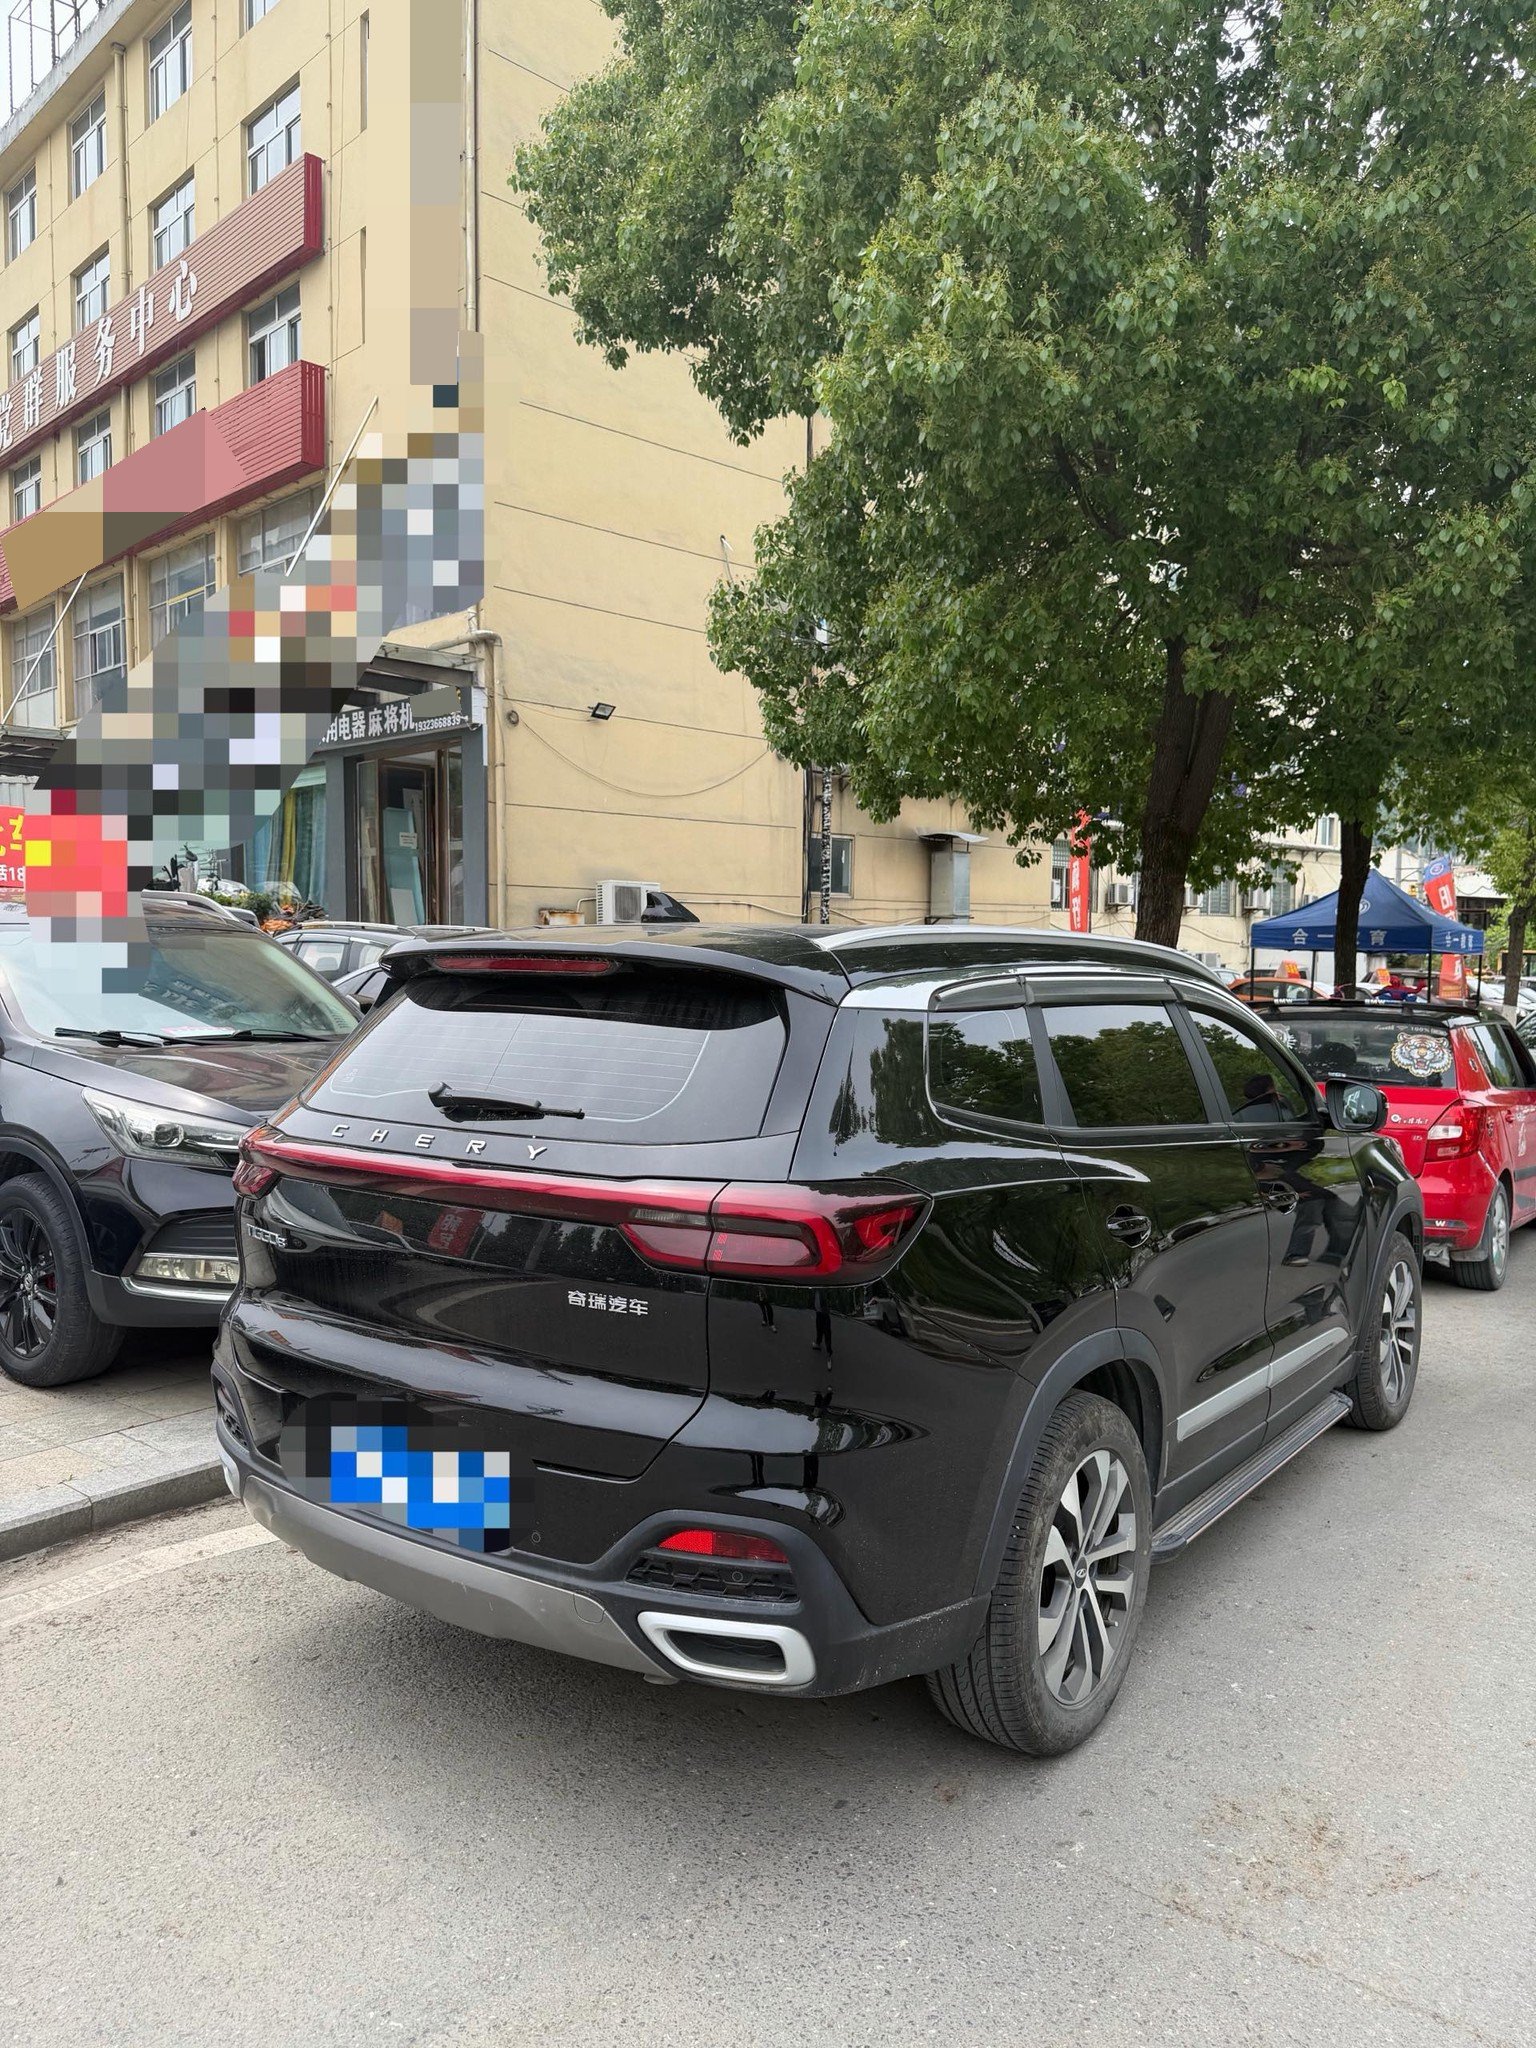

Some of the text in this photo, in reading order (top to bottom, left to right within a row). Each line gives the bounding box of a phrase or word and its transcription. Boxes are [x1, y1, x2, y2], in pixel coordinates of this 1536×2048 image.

[331, 1124, 548, 1160] CHERY
[567, 1290, 649, 1316] 奇瑞汽车
